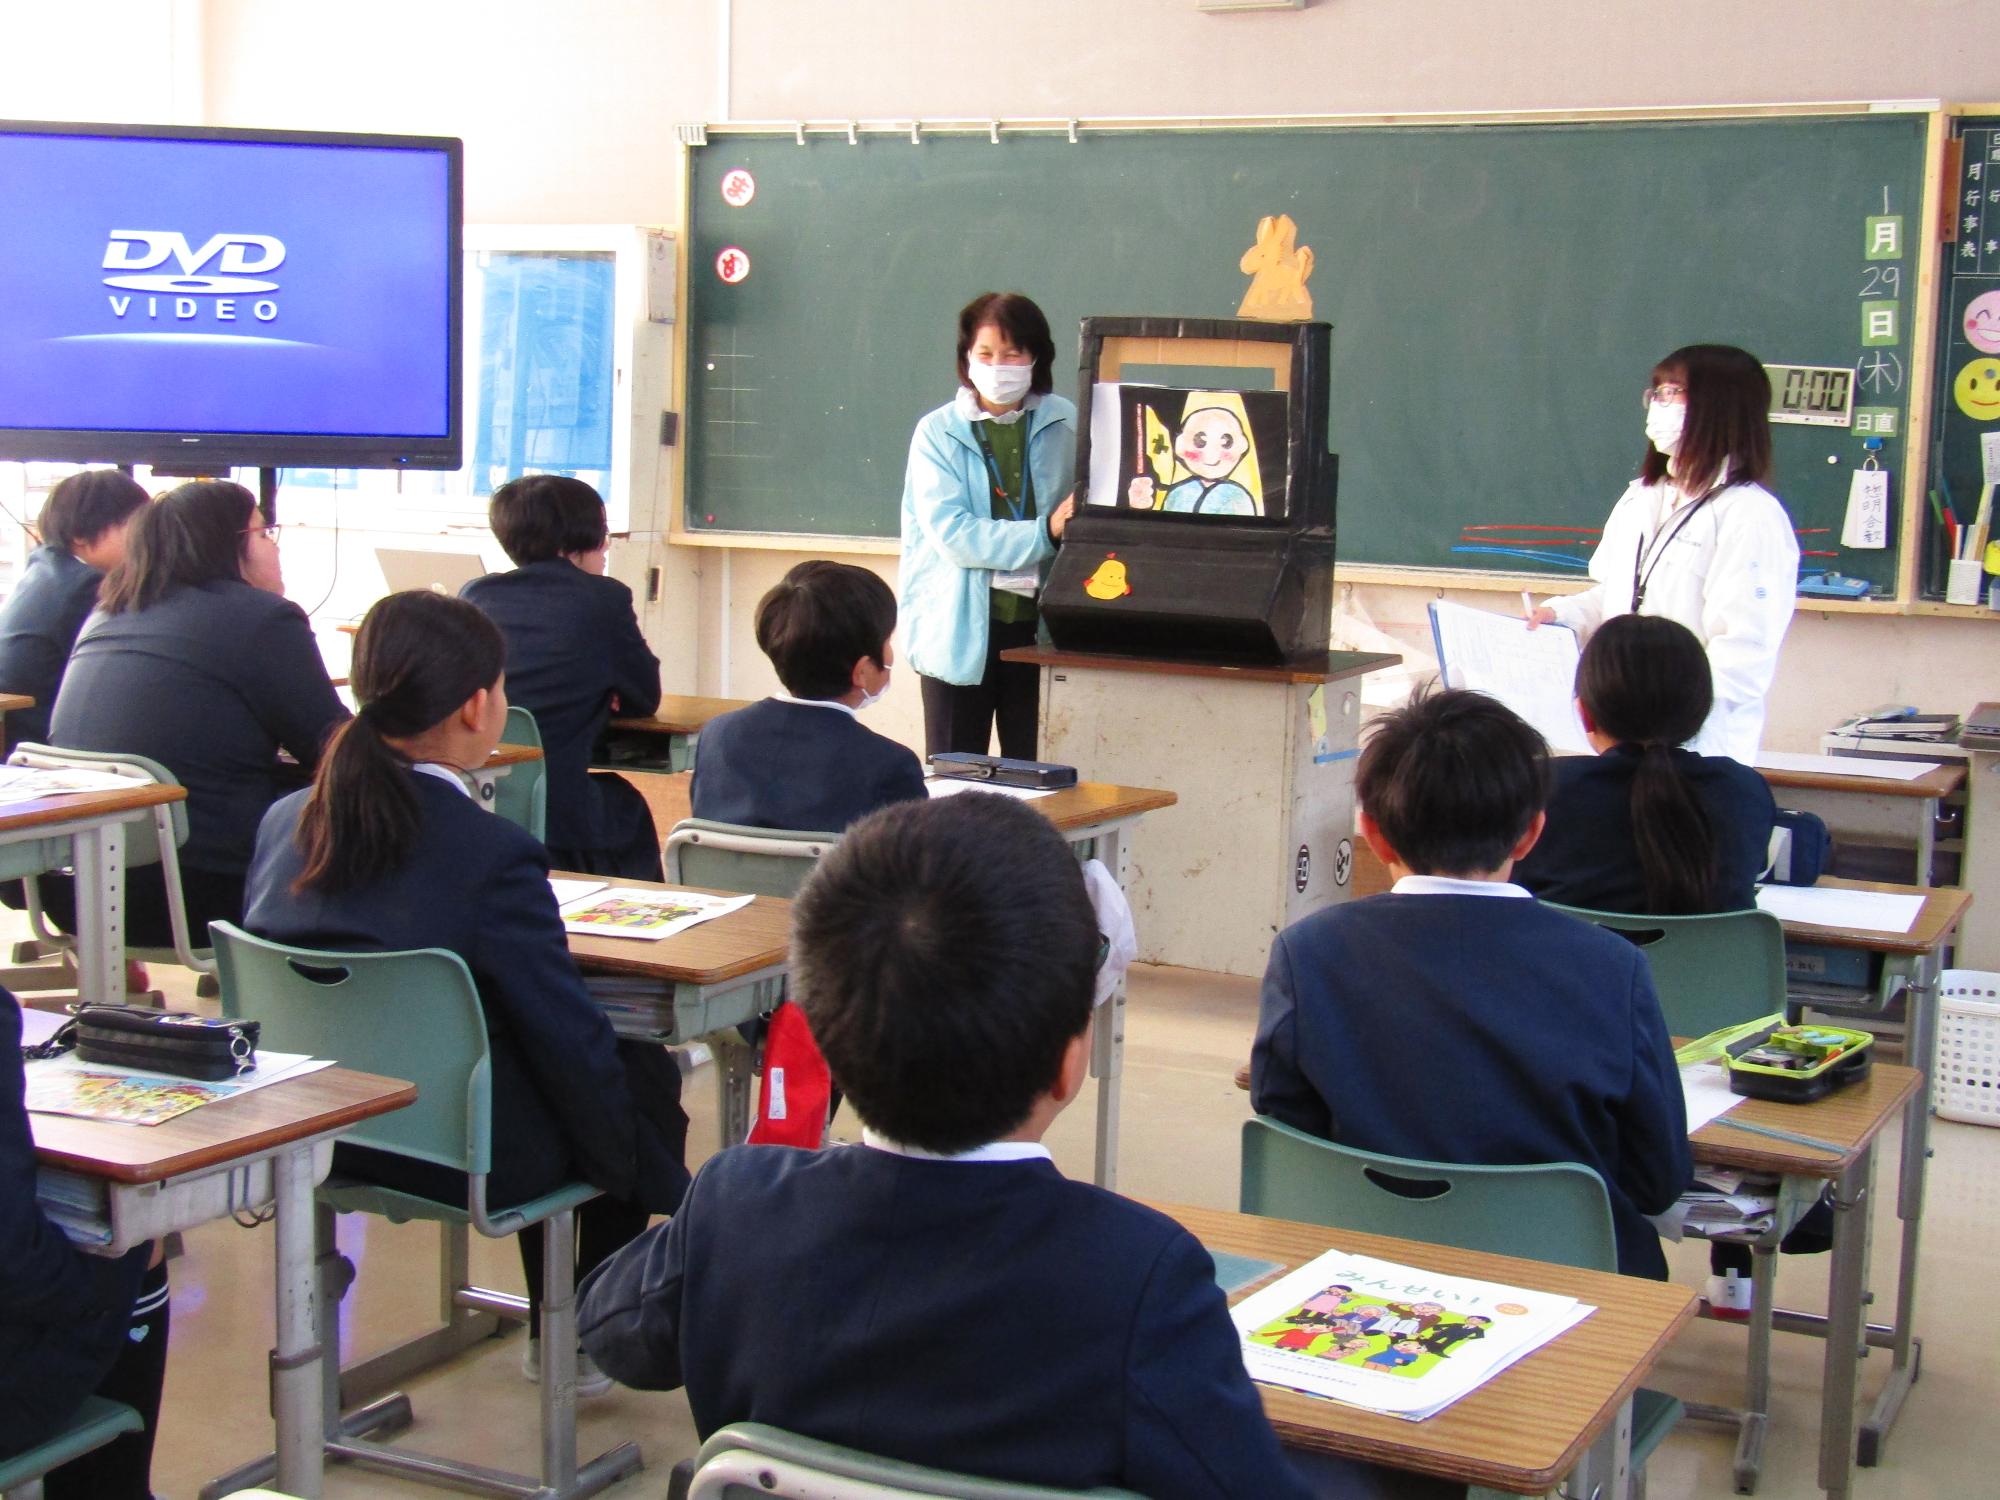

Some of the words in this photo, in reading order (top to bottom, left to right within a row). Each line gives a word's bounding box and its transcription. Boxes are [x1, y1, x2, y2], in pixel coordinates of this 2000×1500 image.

[1960, 162, 1983, 258] 月行事表
[102, 229, 286, 276] DVD
[108, 295, 278, 321] VIDEO
[1783, 369, 1851, 412] 0:00
[1855, 413, 1895, 433] 日直
